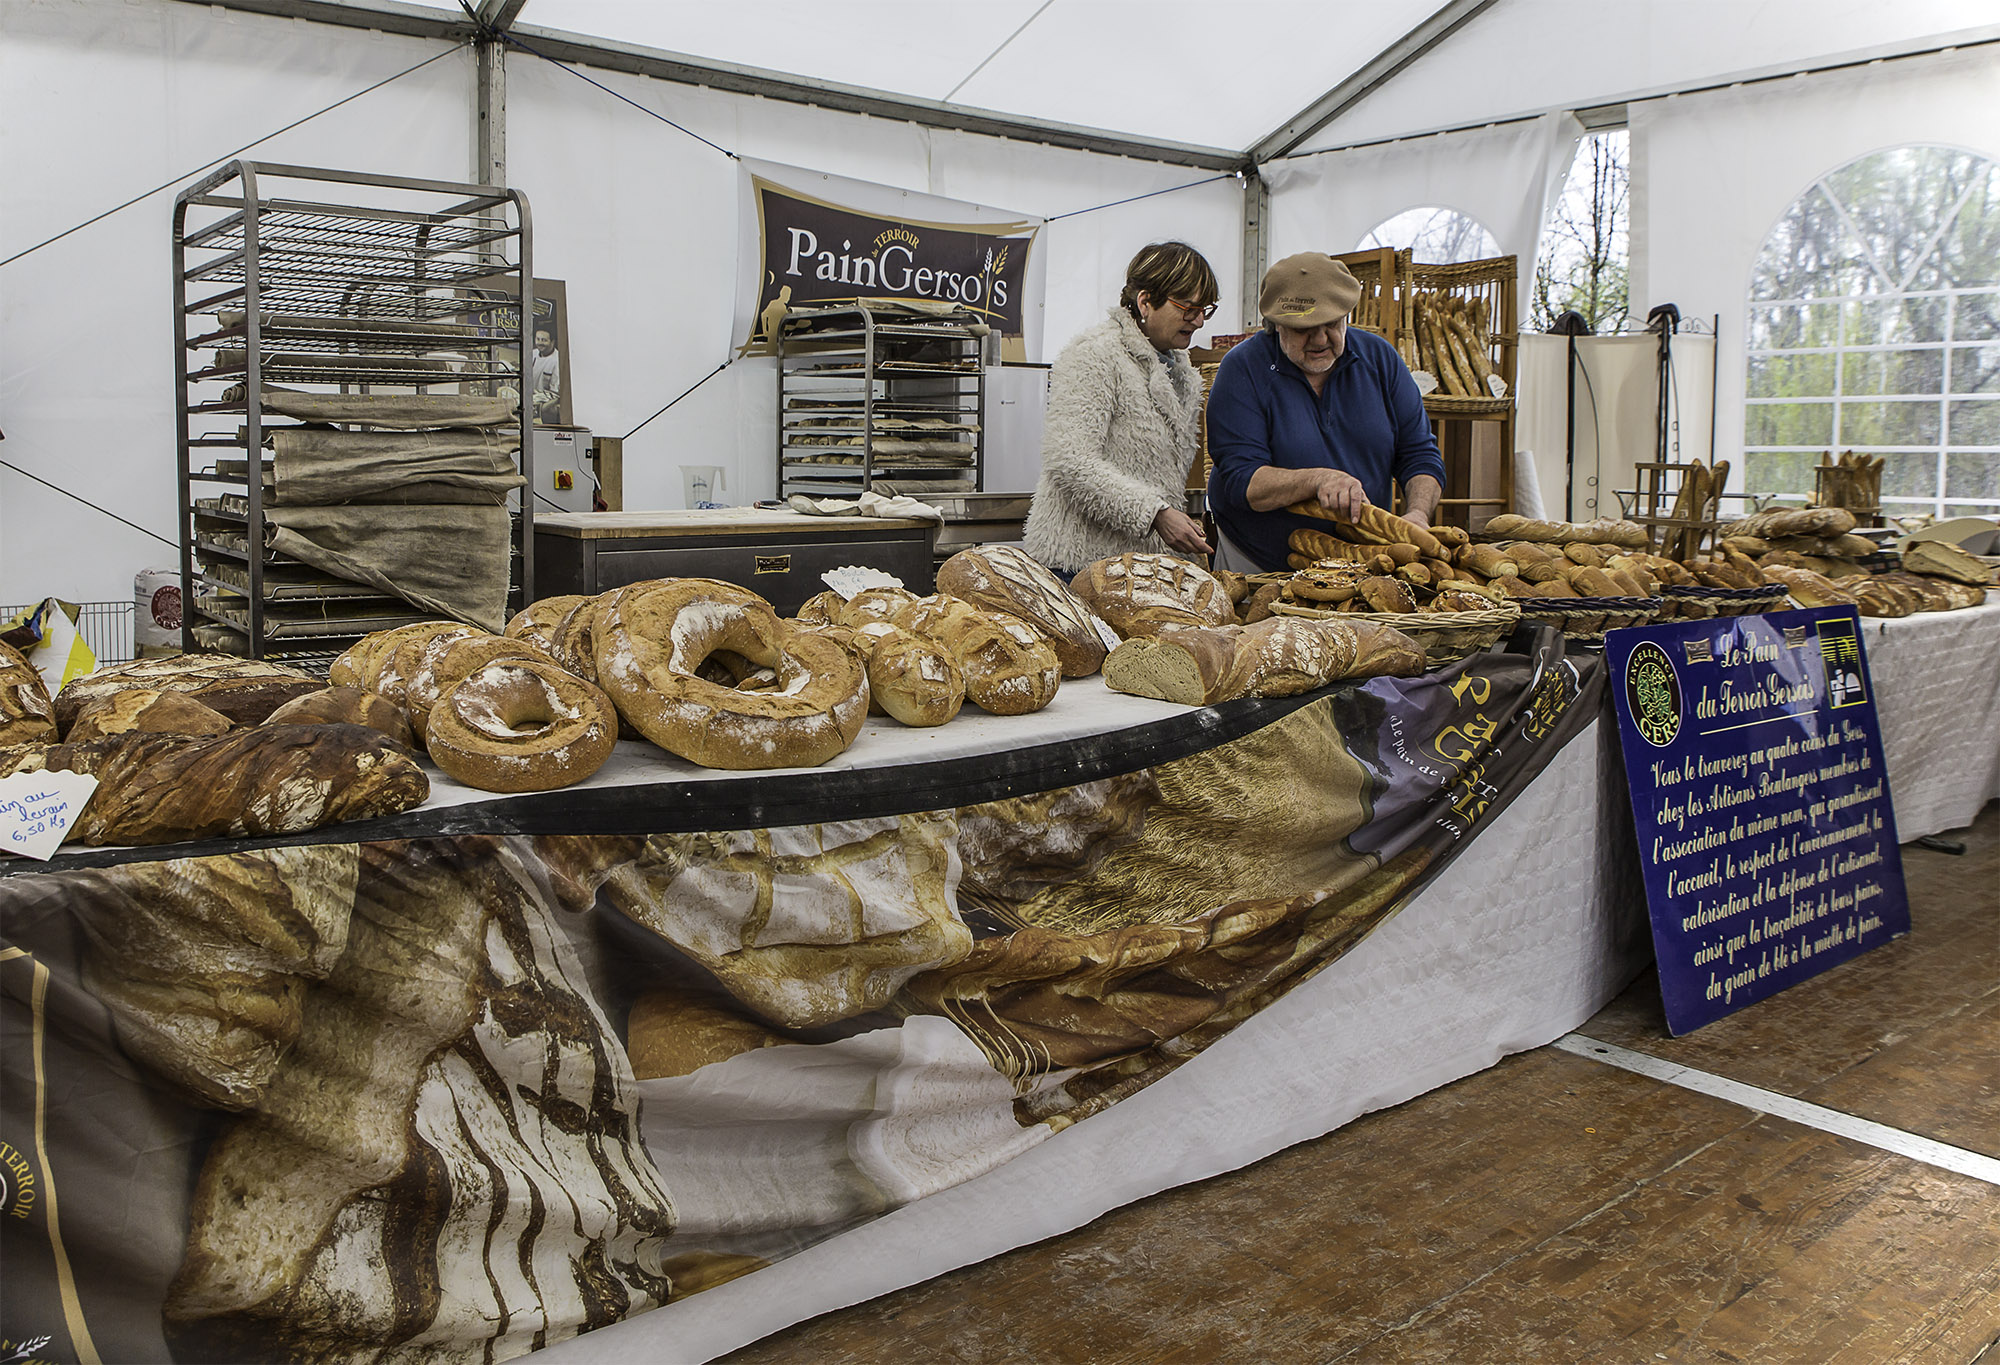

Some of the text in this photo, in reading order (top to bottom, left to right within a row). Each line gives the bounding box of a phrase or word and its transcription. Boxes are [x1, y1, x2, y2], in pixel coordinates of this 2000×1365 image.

[873, 228, 920, 250] TERROIR
[1630, 648, 1675, 685] EXCELLENCE
[1720, 634, 1740, 668] Le
[1741, 631, 1779, 664] Pain
[1696, 672, 1815, 719] du Terroir Gersois
[1639, 710, 1680, 744] GERS
[1650, 719, 1867, 788] Vous le trouverez au quatre coins du Gers,
[1392, 739, 1415, 766] pain
[1418, 766, 1439, 777] de
[24, 792, 61, 803] au
[1657, 747, 1871, 831] chez les Artisans Boulangers membres de
[12, 822, 45, 842] 6,50
[1653, 835, 1726, 865] l'association
[1729, 816, 1744, 841] du
[1780, 808, 1807, 827] nom,
[1809, 795, 1825, 827] qui
[1827, 777, 1882, 822] garantissent
[1667, 808, 1883, 899] l'accueil, le respect de l'environnement, la
[1682, 842, 1883, 933] valorisation et la défense de l'artisanat,
[1694, 879, 1884, 967] ainsi que la traçabilité de leurs pains,
[1706, 911, 1884, 1005] du grain de blé à la miette de pain.
[0, 1141, 36, 1219] TERROIR
